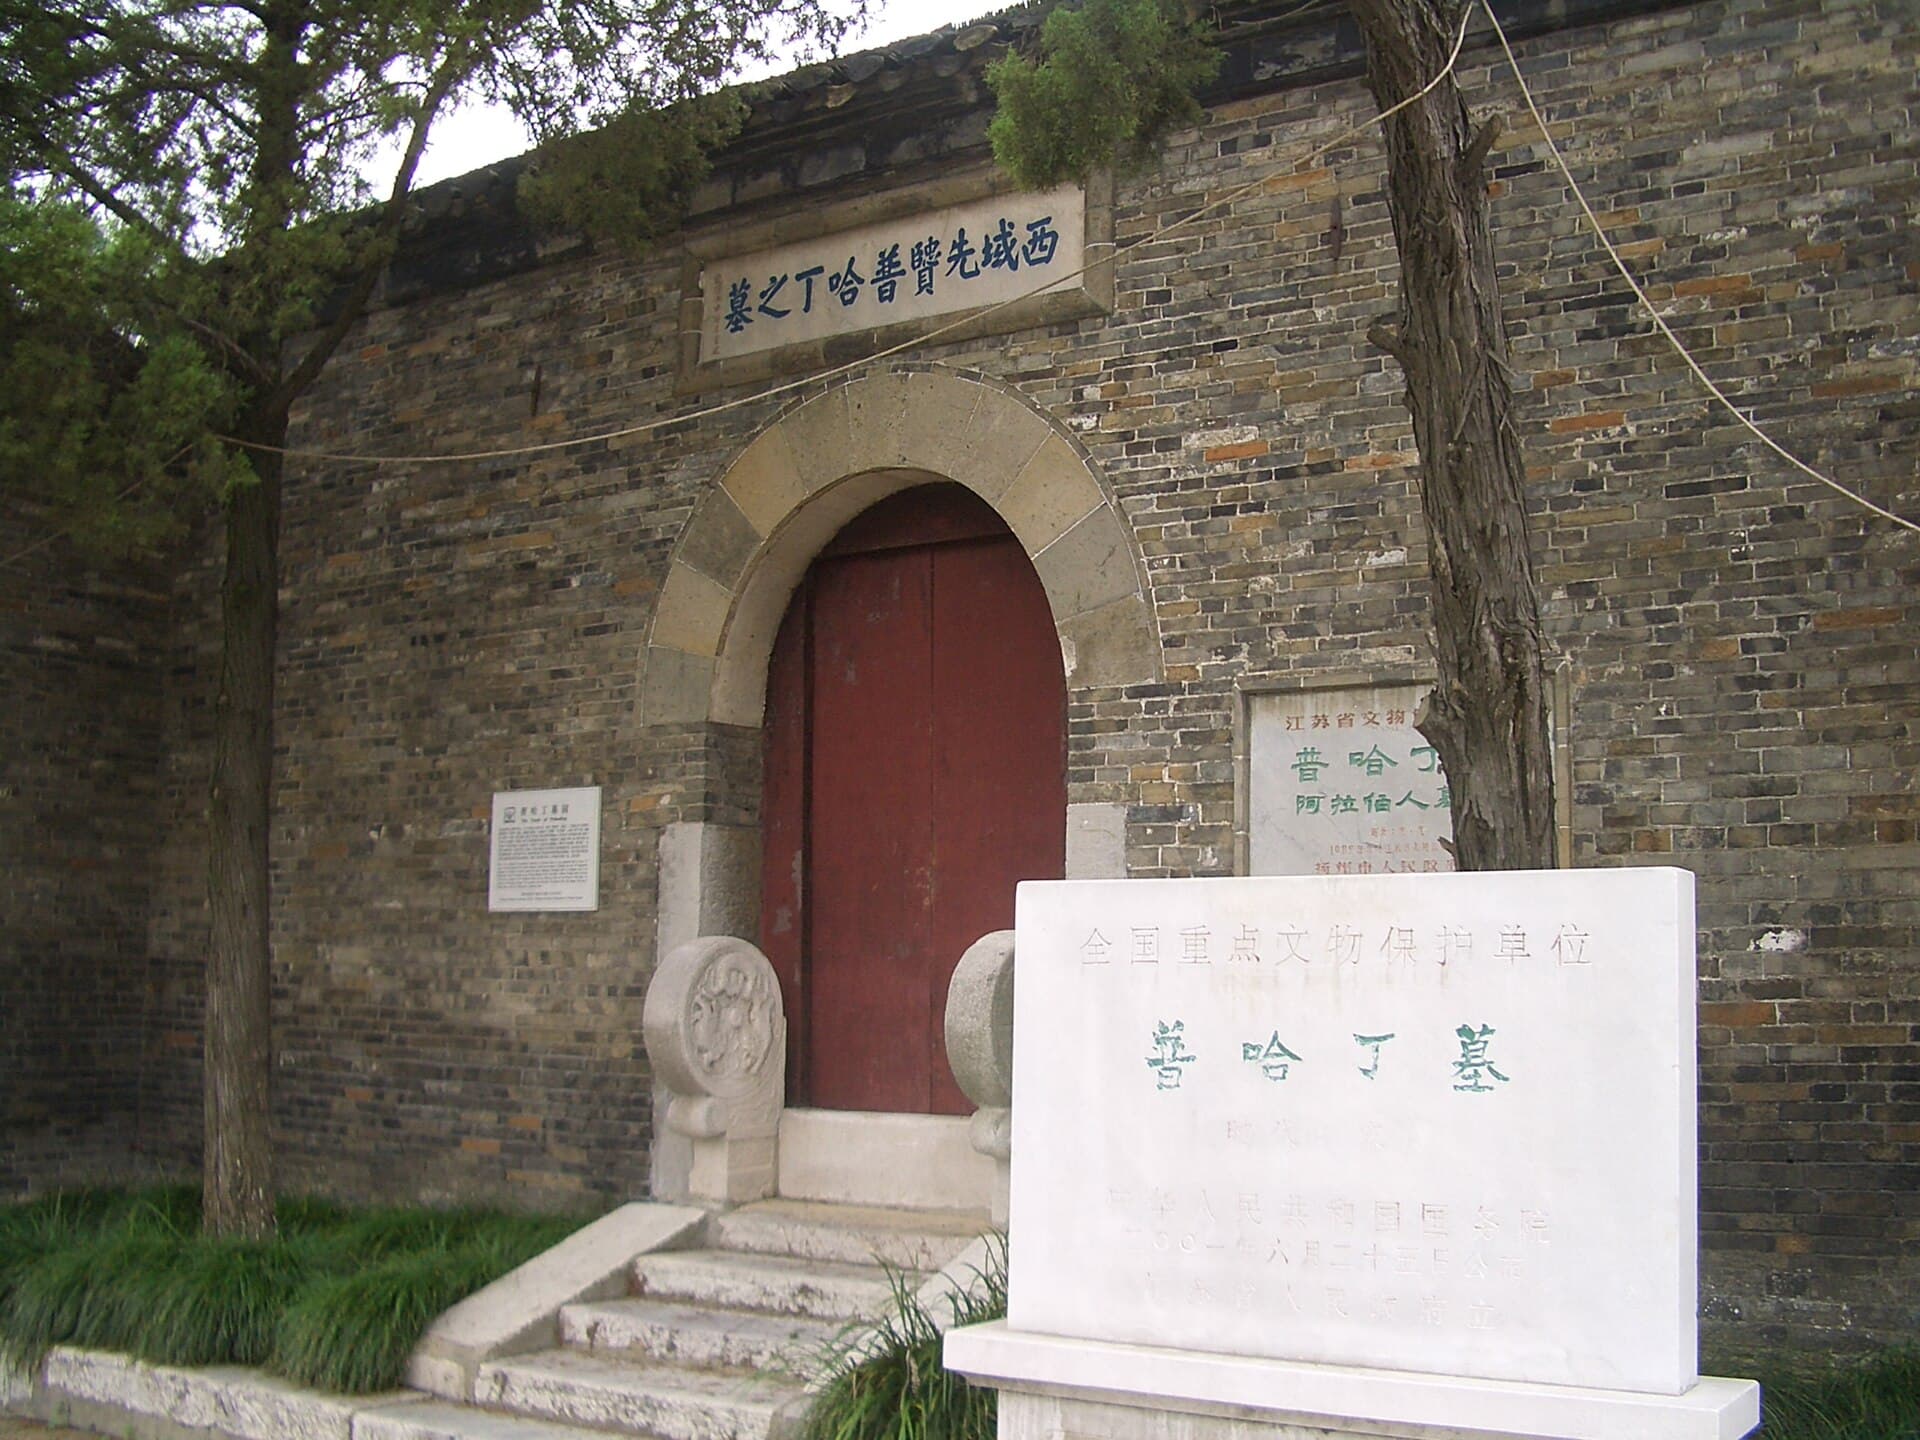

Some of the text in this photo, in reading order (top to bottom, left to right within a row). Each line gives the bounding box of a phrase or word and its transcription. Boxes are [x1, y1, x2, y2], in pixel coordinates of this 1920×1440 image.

[1285, 707, 1418, 731] 江苏省文物
[1079, 922, 1592, 968] 全国重点文物保护单位
[1144, 1019, 1510, 1093] 普哈丁墓
